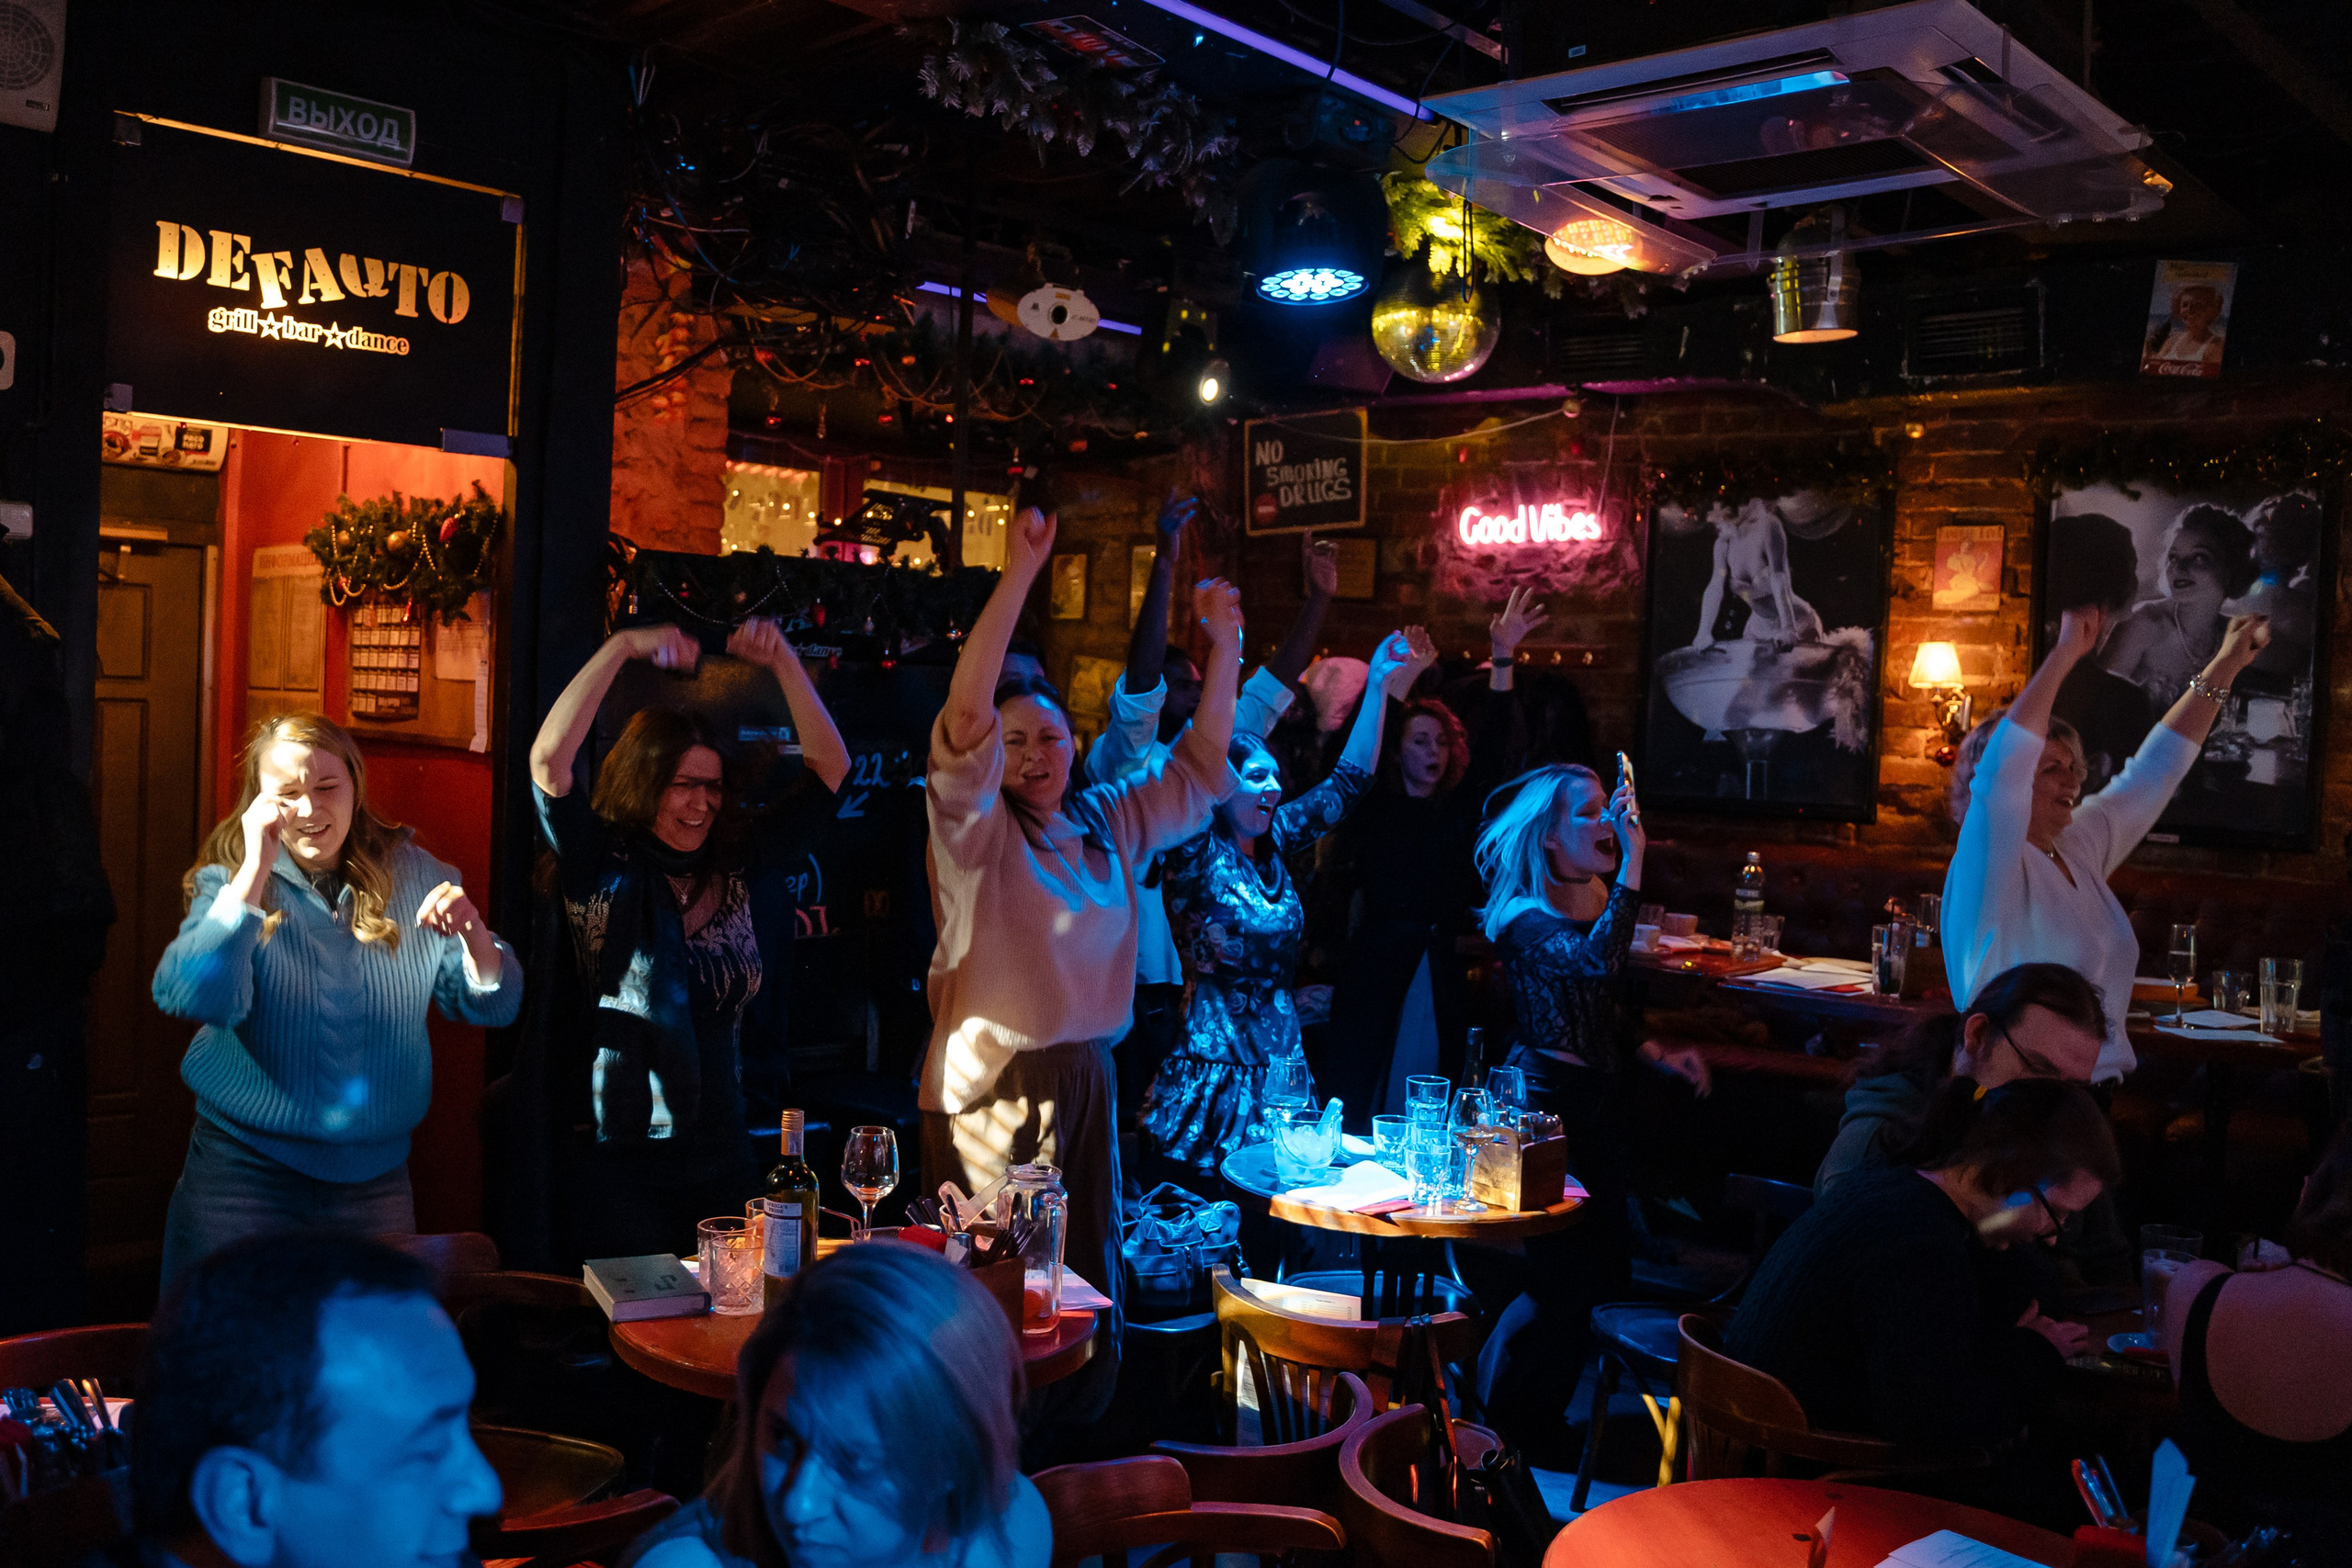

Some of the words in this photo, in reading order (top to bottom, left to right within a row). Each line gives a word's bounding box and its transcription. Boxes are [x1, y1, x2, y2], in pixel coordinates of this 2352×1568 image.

[288, 96, 401, 151] ВЫХОД
[208, 307, 258, 334] grill
[282, 315, 322, 343] bar
[345, 326, 410, 355] dance
[1254, 439, 1284, 467] NO
[1279, 478, 1352, 508] DRUGS
[1458, 506, 1527, 546] Good
[1527, 502, 1603, 544] Vibes
